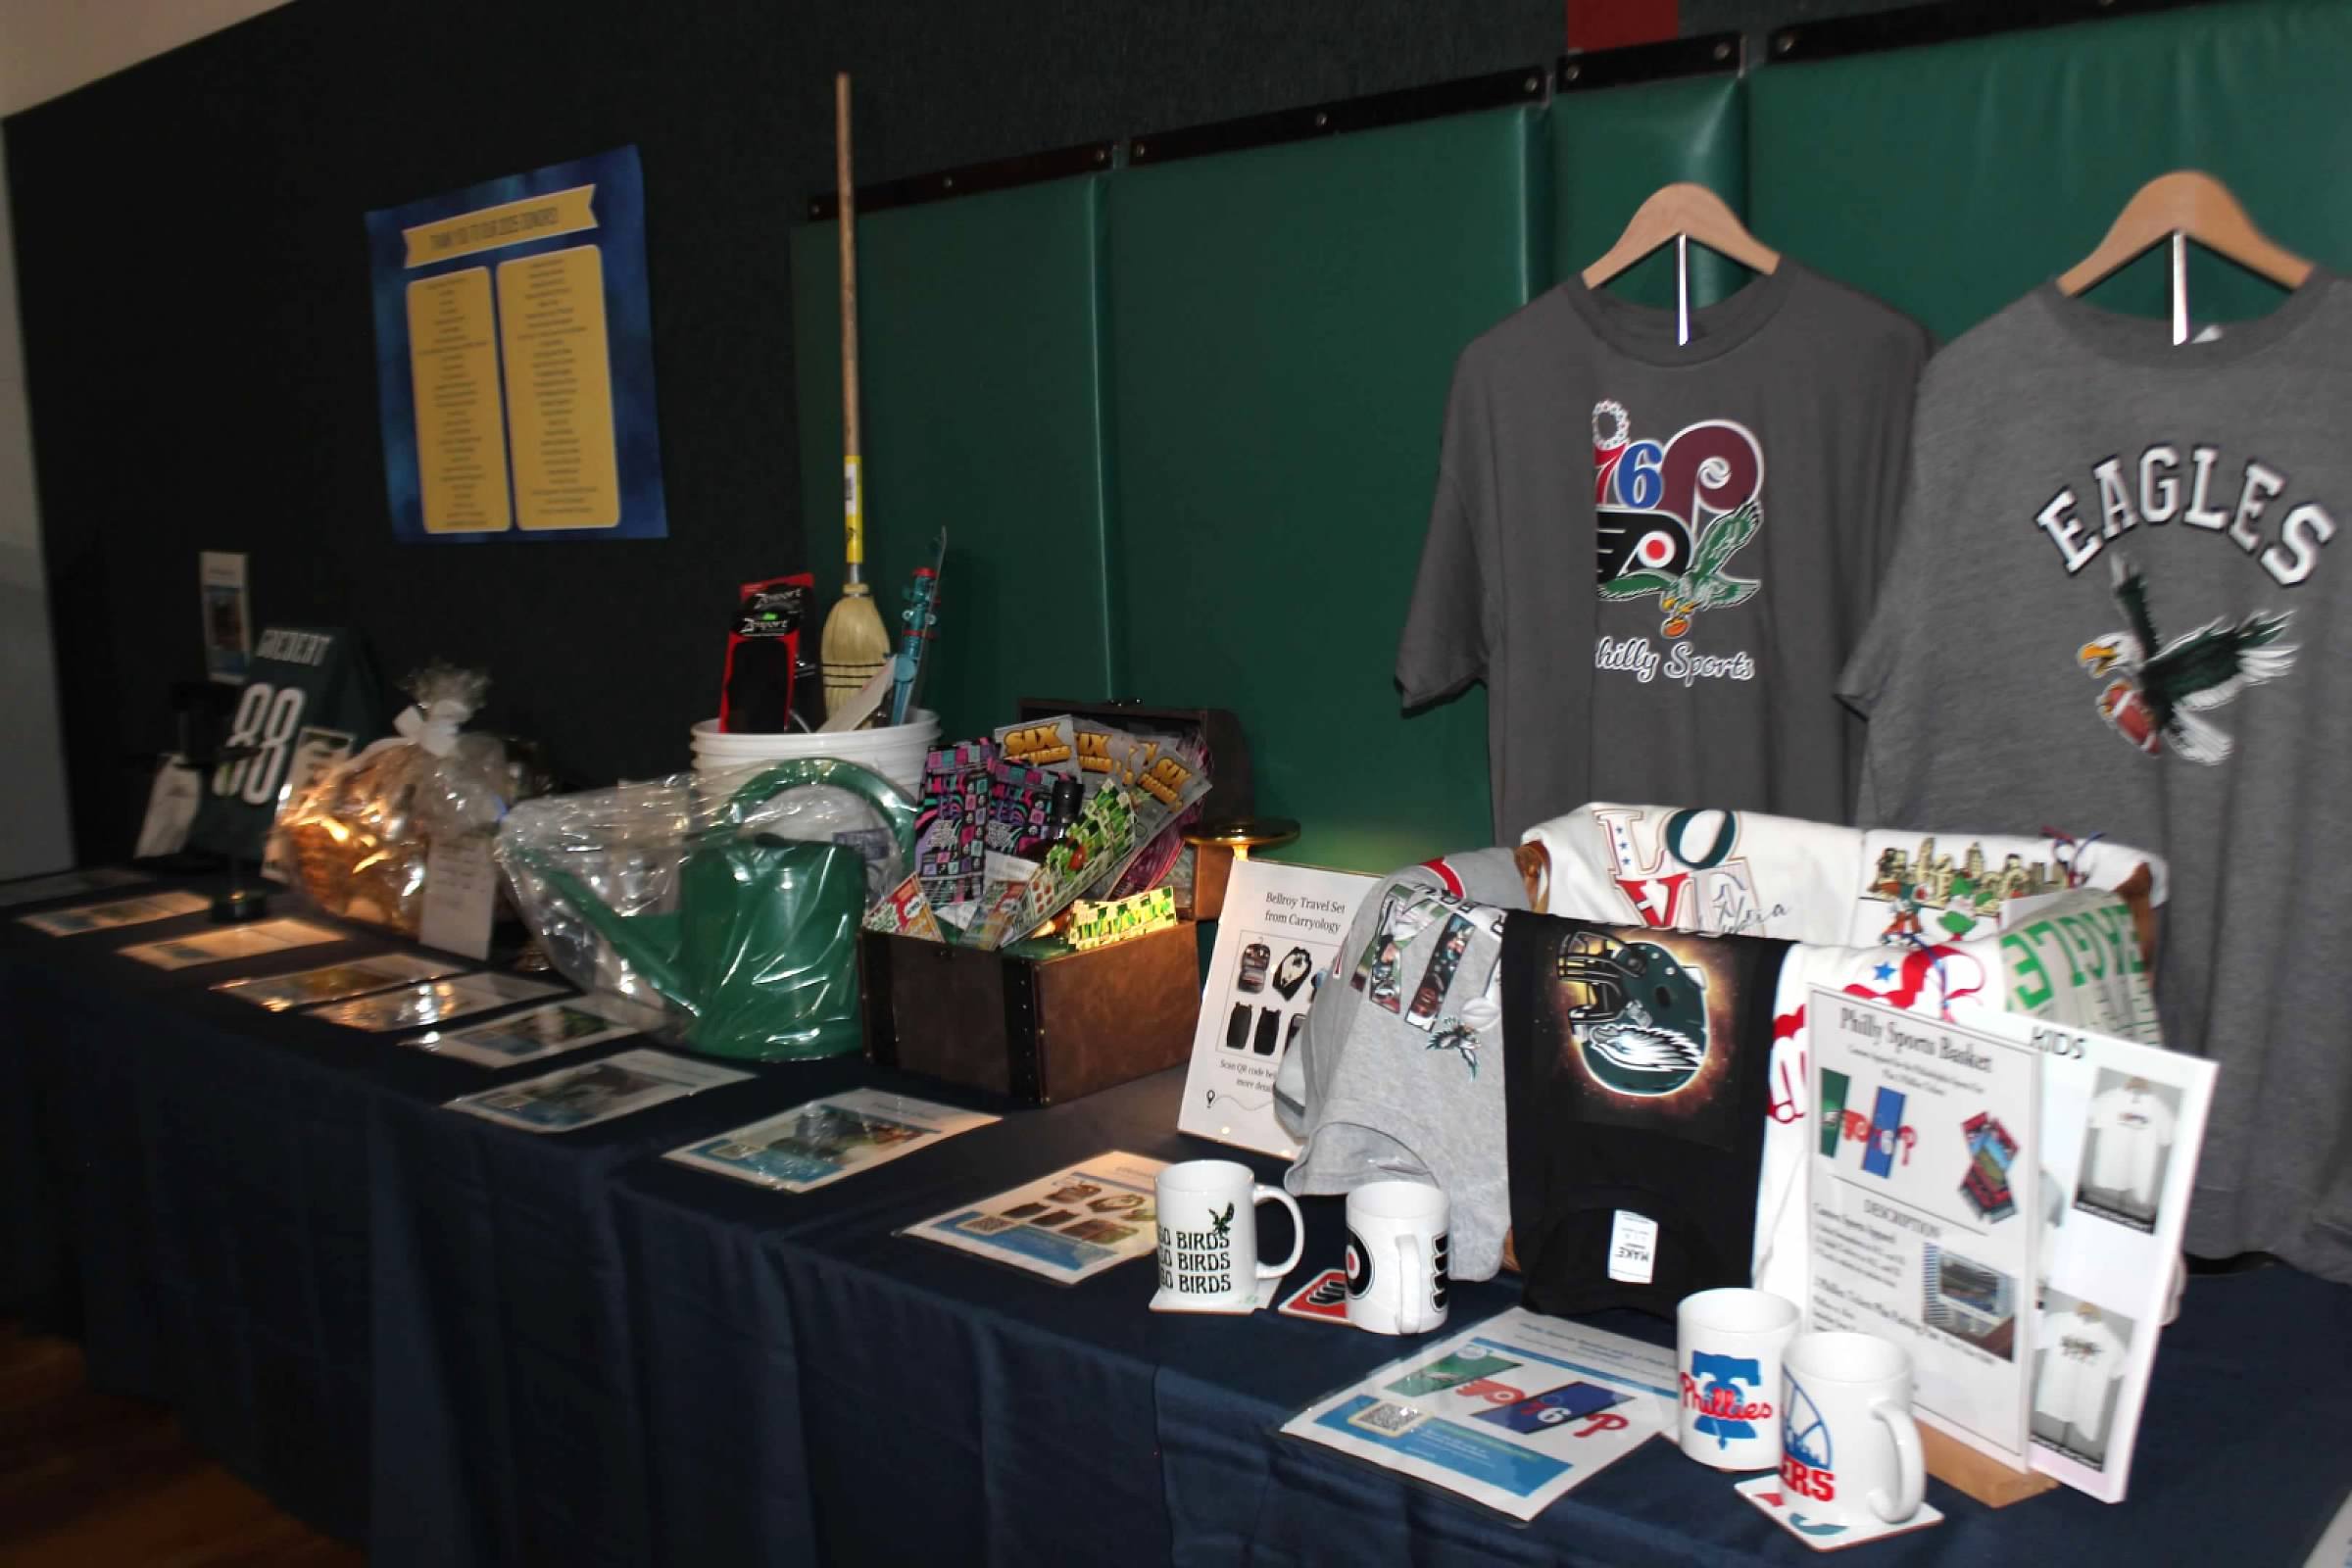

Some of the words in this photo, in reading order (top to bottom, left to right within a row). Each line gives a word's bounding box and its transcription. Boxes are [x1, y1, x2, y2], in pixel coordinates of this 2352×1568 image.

[2034, 442, 2337, 588] EAGLES
[1663, 640, 1756, 688] Sports
[1265, 892, 1298, 909] Bellroy
[1300, 896, 1330, 911] Travel
[1331, 901, 1347, 914] Set
[1265, 909, 1288, 923] from
[1289, 913, 1342, 934] Carryology
[1839, 1006, 1883, 1046] Philly
[1886, 1020, 1936, 1056] Sports
[1938, 1036, 1993, 1073] Basket
[2031, 1025, 2088, 1060] KIDS
[1176, 1231, 1230, 1250] BIRDS
[1177, 1251, 1231, 1272] BIRDS
[1178, 1274, 1232, 1295] BIRDS
[1679, 1371, 1773, 1420] Phillies
